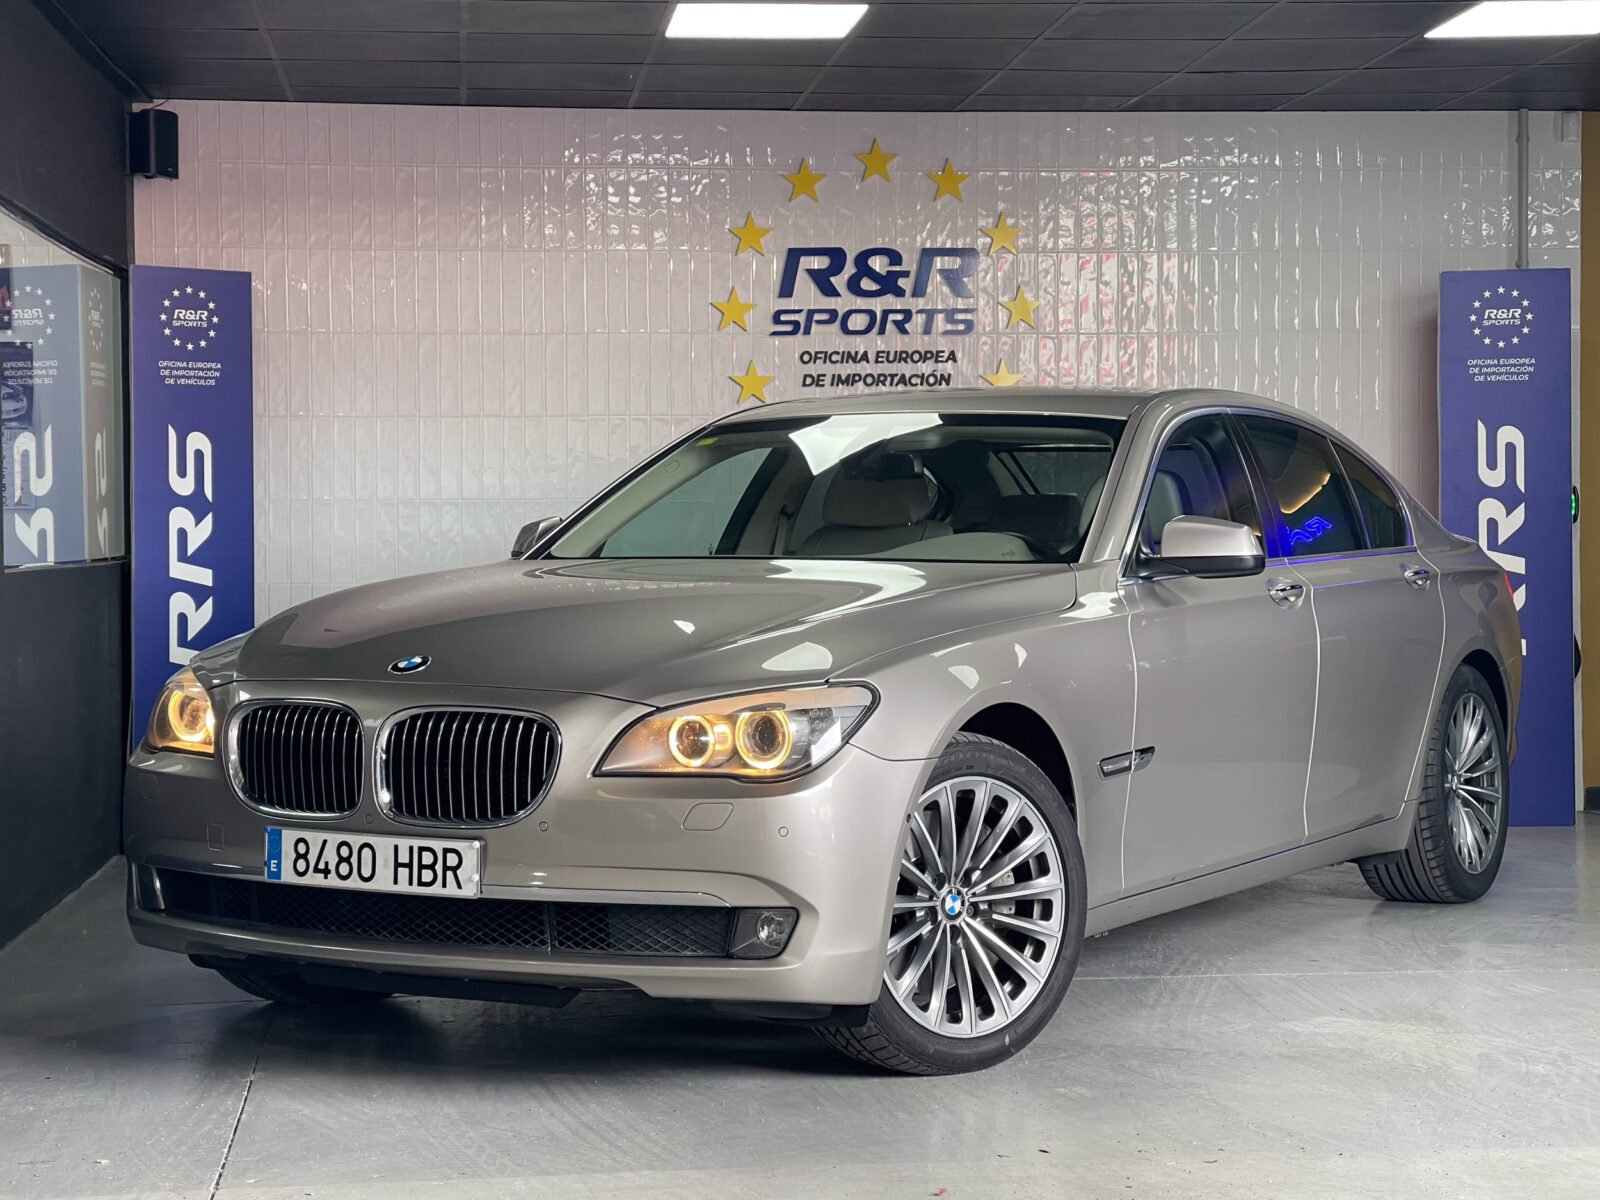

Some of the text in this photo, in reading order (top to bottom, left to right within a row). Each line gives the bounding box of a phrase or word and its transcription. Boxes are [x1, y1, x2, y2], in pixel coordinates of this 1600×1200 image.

[777, 247, 980, 298] R&R
[173, 309, 208, 321] R&R
[1484, 309, 1522, 319] R&R
[172, 320, 208, 328] SPORTS
[769, 308, 977, 336] SPORTS
[799, 349, 958, 364] OFICINA EUROPEA
[158, 360, 221, 369] OFICINA EUROPEA
[1481, 365, 1535, 373] IMPORTACIÓN
[171, 369, 220, 377] IMPORTACIÓN
[801, 369, 952, 387] DE IMPORTACIÓN
[176, 377, 216, 386] VEHÍCULOS
[1477, 419, 1527, 656] RS
[168, 424, 213, 666] RRS
[270, 860, 278, 872] E
[292, 837, 464, 890] 8480 HBR
